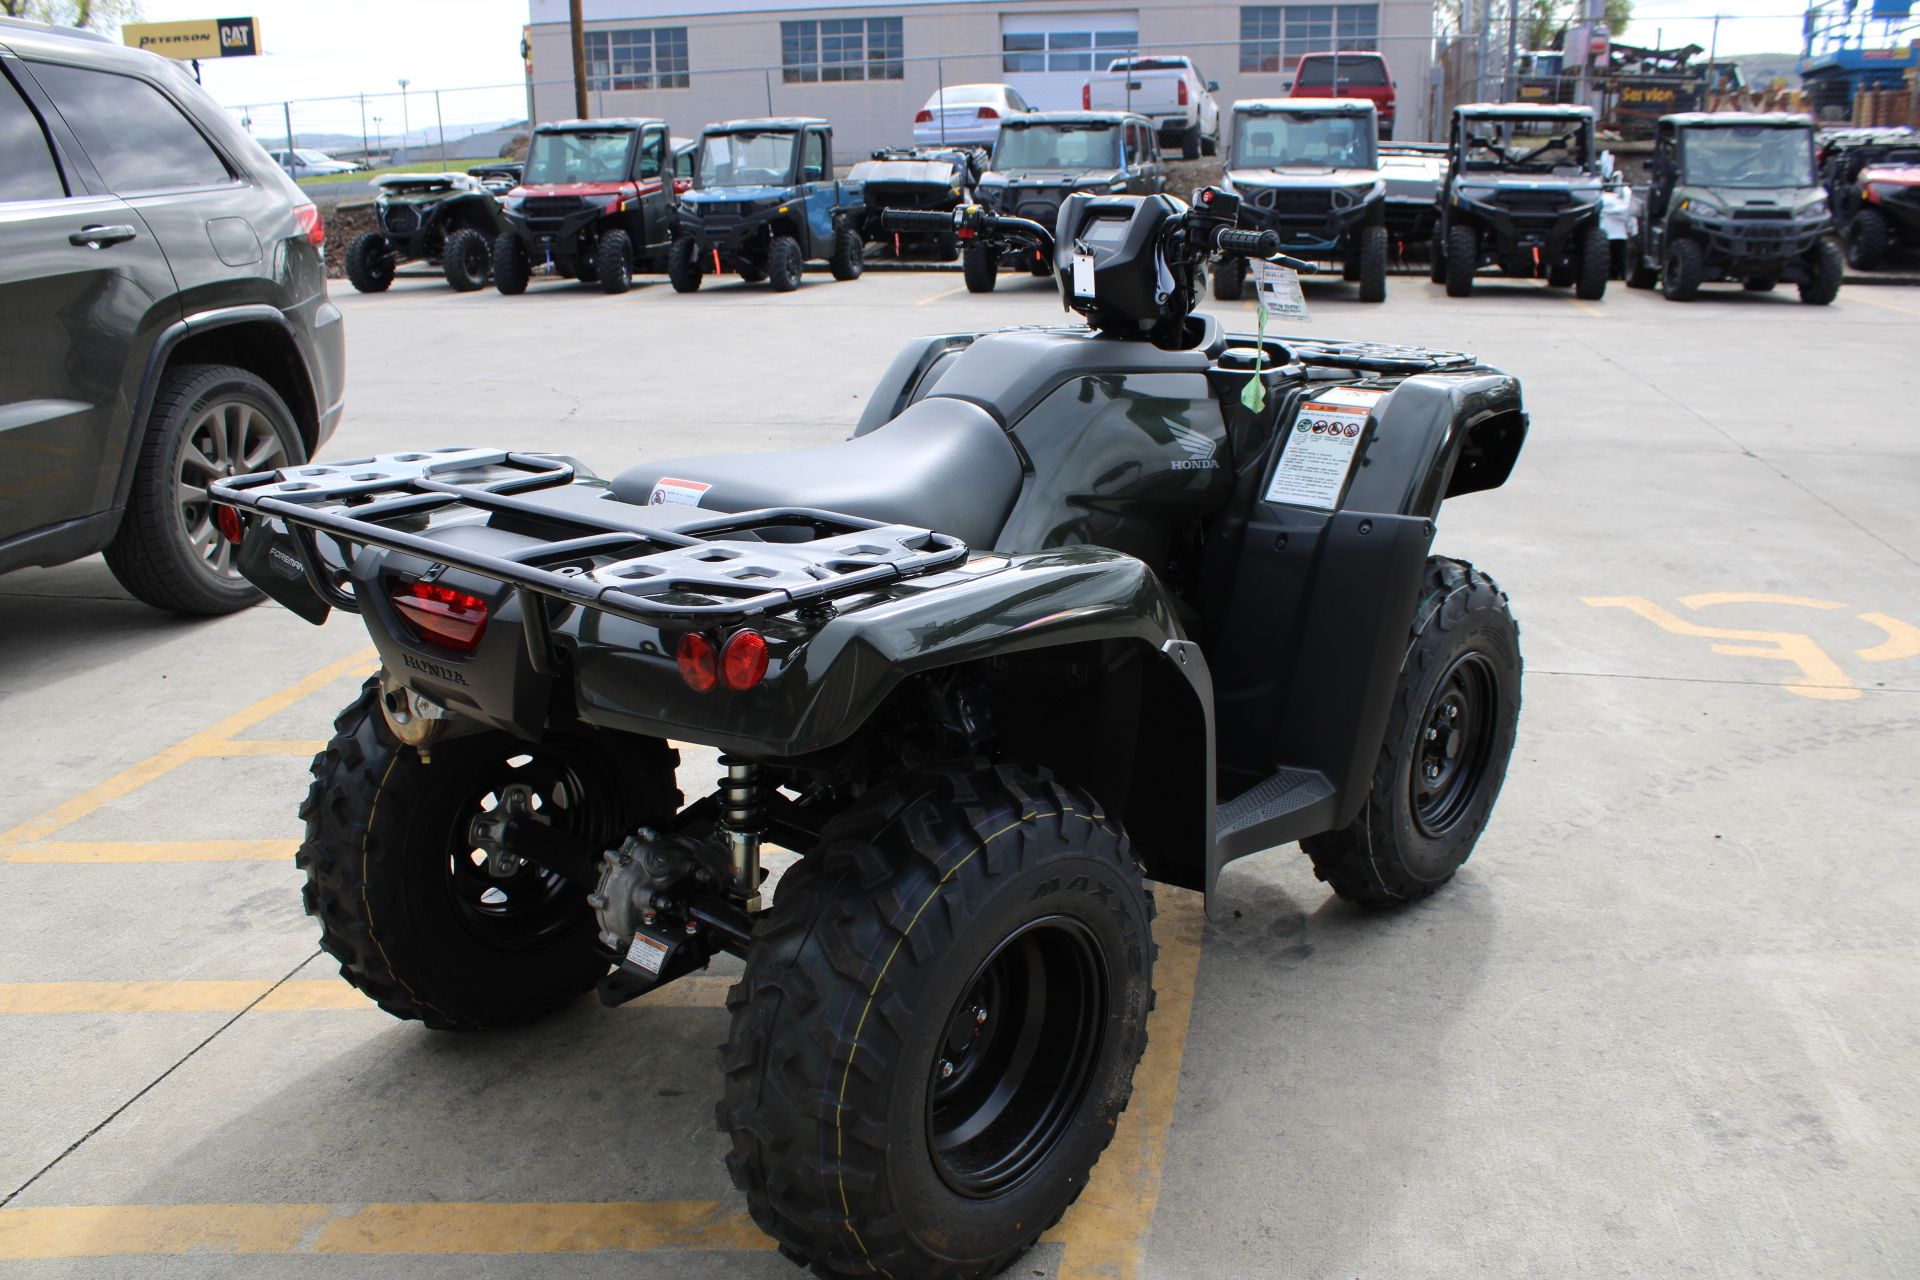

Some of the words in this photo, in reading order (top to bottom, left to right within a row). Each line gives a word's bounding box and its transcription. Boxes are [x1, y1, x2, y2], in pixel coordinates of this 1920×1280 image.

[221, 26, 248, 47] CAT
[1622, 87, 1675, 102] Service
[1171, 460, 1219, 470] HONDA
[269, 547, 304, 572] FOREMAN
[402, 653, 469, 687] HONDA
[1031, 875, 1142, 973] MAXXIS
